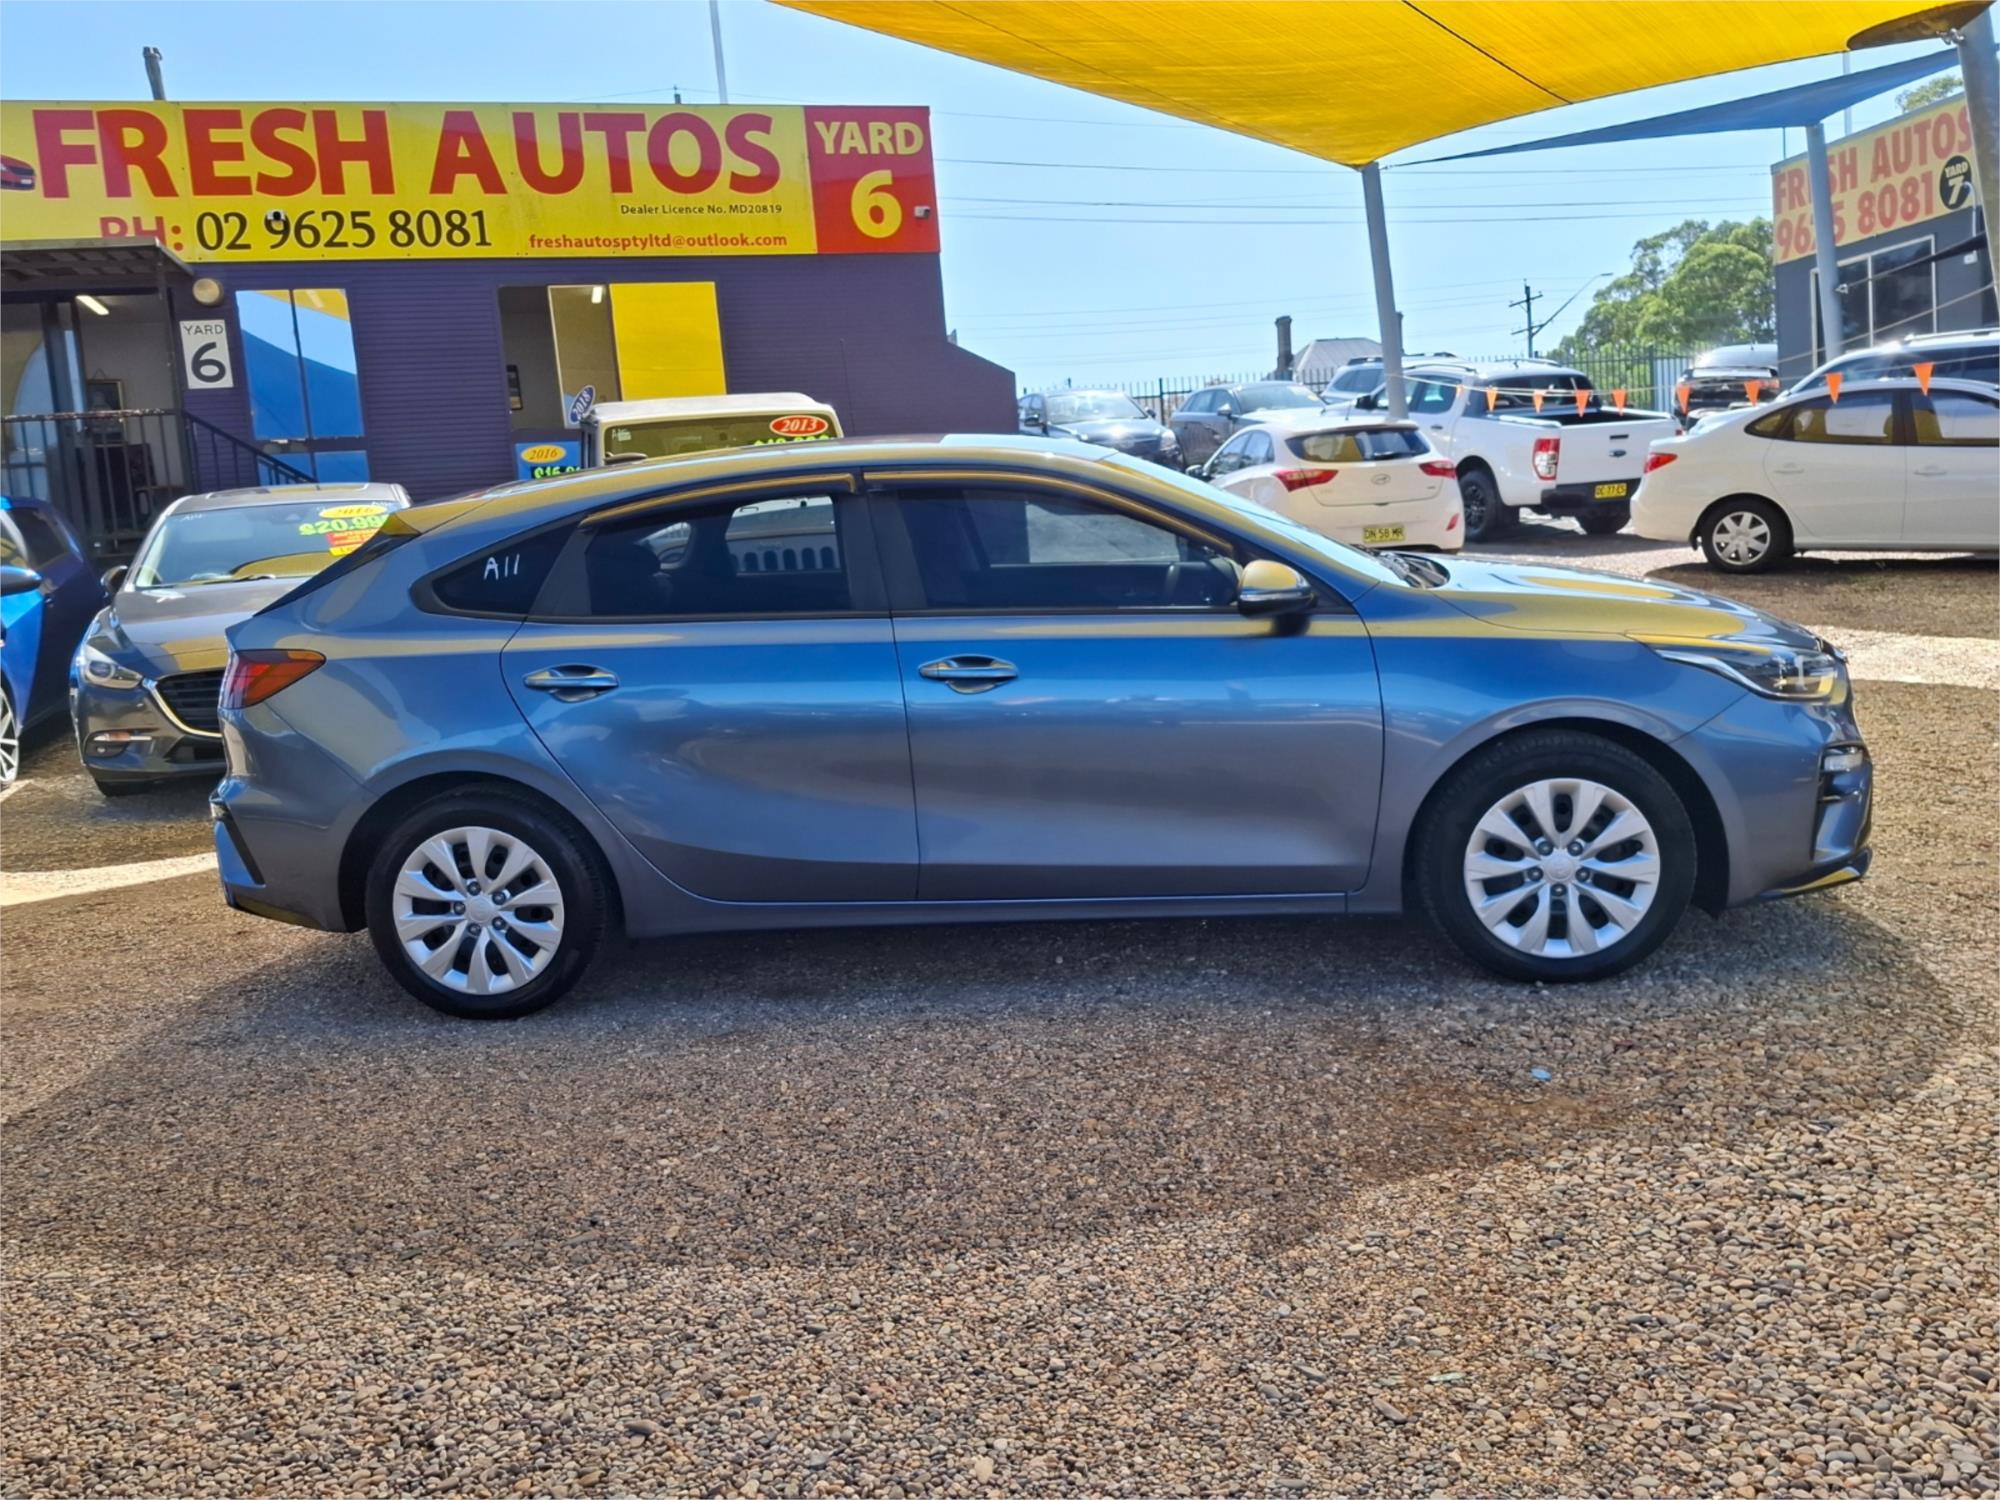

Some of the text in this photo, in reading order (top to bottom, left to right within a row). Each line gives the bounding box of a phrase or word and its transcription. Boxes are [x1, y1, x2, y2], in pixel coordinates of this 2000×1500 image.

[813, 120, 924, 156] YARD
[32, 108, 782, 198] FRESH AUTOS
[1944, 161, 1968, 179] YARD
[850, 169, 903, 239] 6
[1947, 177, 1966, 205] 7
[620, 204, 782, 215] Dealer Licence No. MD20819
[1776, 171, 1934, 260] 965 8081
[99, 209, 492, 251] PH: 02 9625 8081
[529, 233, 788, 252] freshautosptyltd@outlook.com
[183, 324, 224, 336] YARD
[191, 341, 226, 384] 6
[781, 418, 818, 433] 2013
[529, 448, 558, 460] 2016
